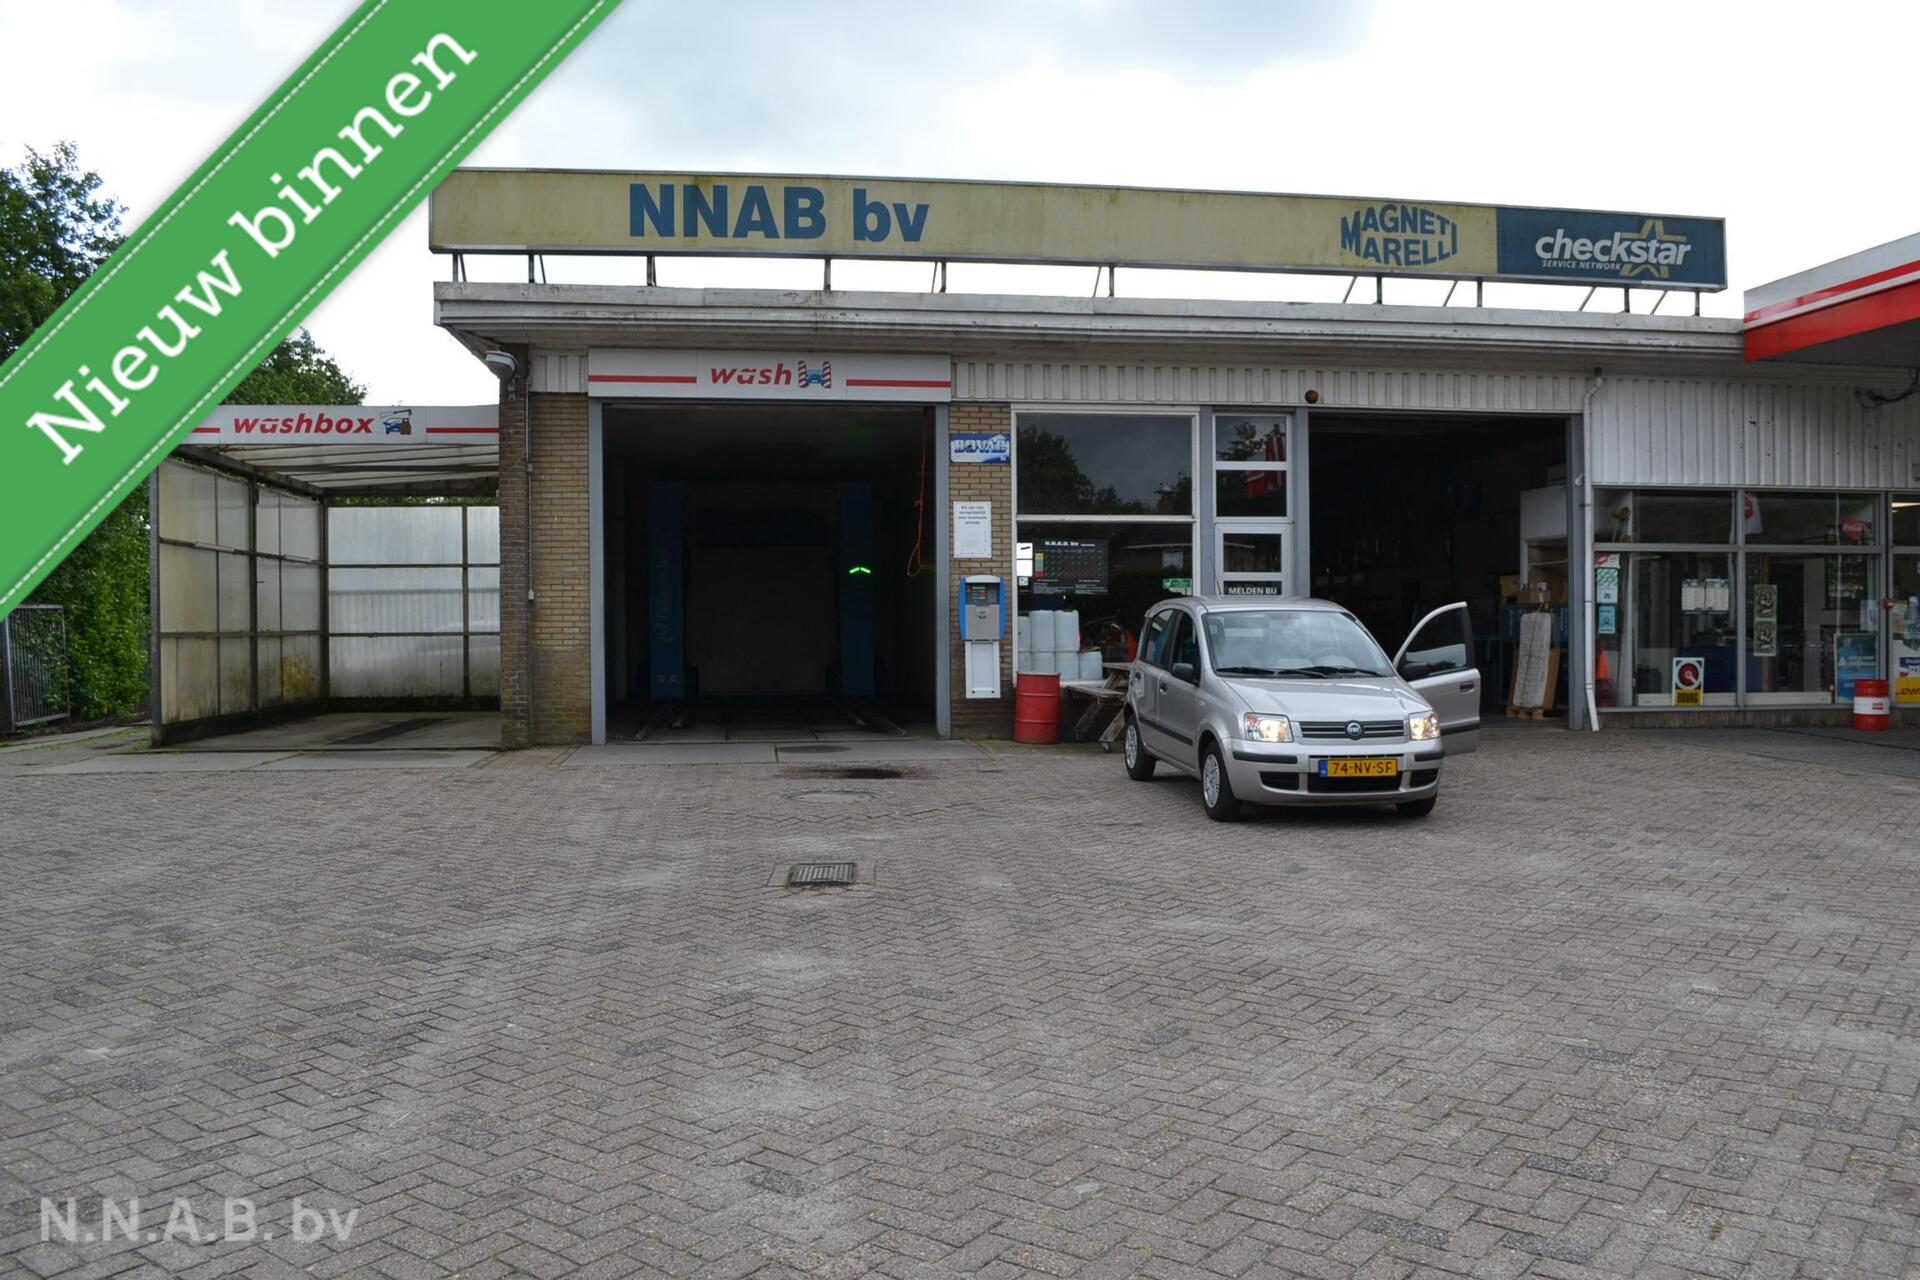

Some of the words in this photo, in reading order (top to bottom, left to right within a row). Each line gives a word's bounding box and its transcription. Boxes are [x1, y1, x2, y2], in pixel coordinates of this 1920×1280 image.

[629, 183, 827, 239] NNAB
[853, 188, 930, 242] bv
[1341, 204, 1457, 242] MAGNETI
[1341, 230, 1457, 266] MARELLI
[1535, 229, 1692, 265] checkstar
[1541, 259, 1577, 269] SERVICE
[1579, 261, 1621, 271] NETWORK
[711, 363, 792, 385] wash
[234, 413, 375, 434] washbox
[1228, 586, 1264, 595] MELDEN
[1331, 761, 1393, 775] 74-NV-SF
